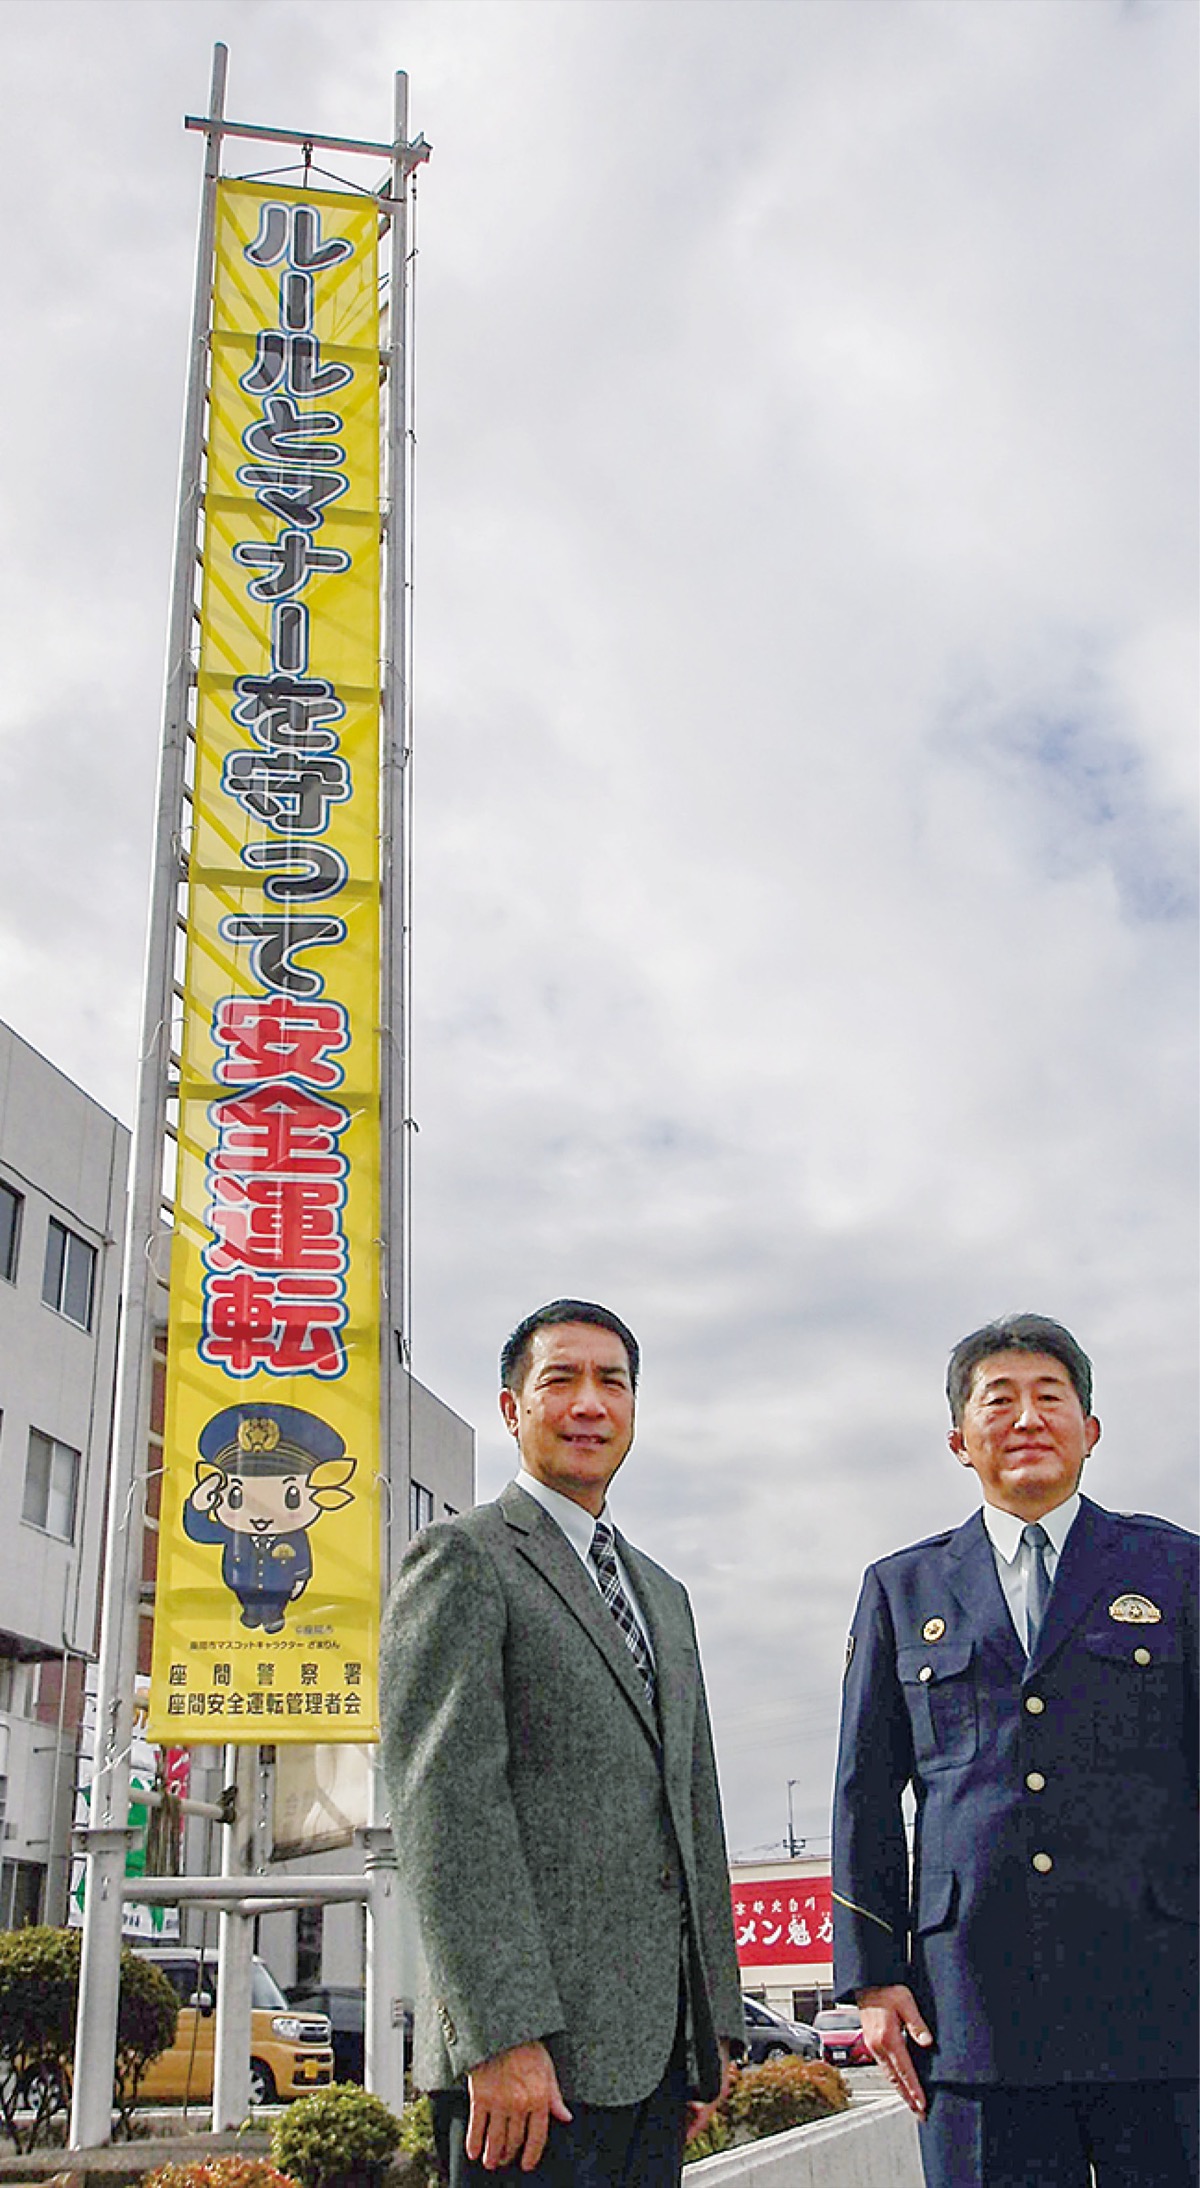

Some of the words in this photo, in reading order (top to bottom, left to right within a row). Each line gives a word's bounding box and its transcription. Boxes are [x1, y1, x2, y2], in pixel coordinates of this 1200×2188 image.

[168, 1692, 362, 1715] 座間安全運転管理者会
